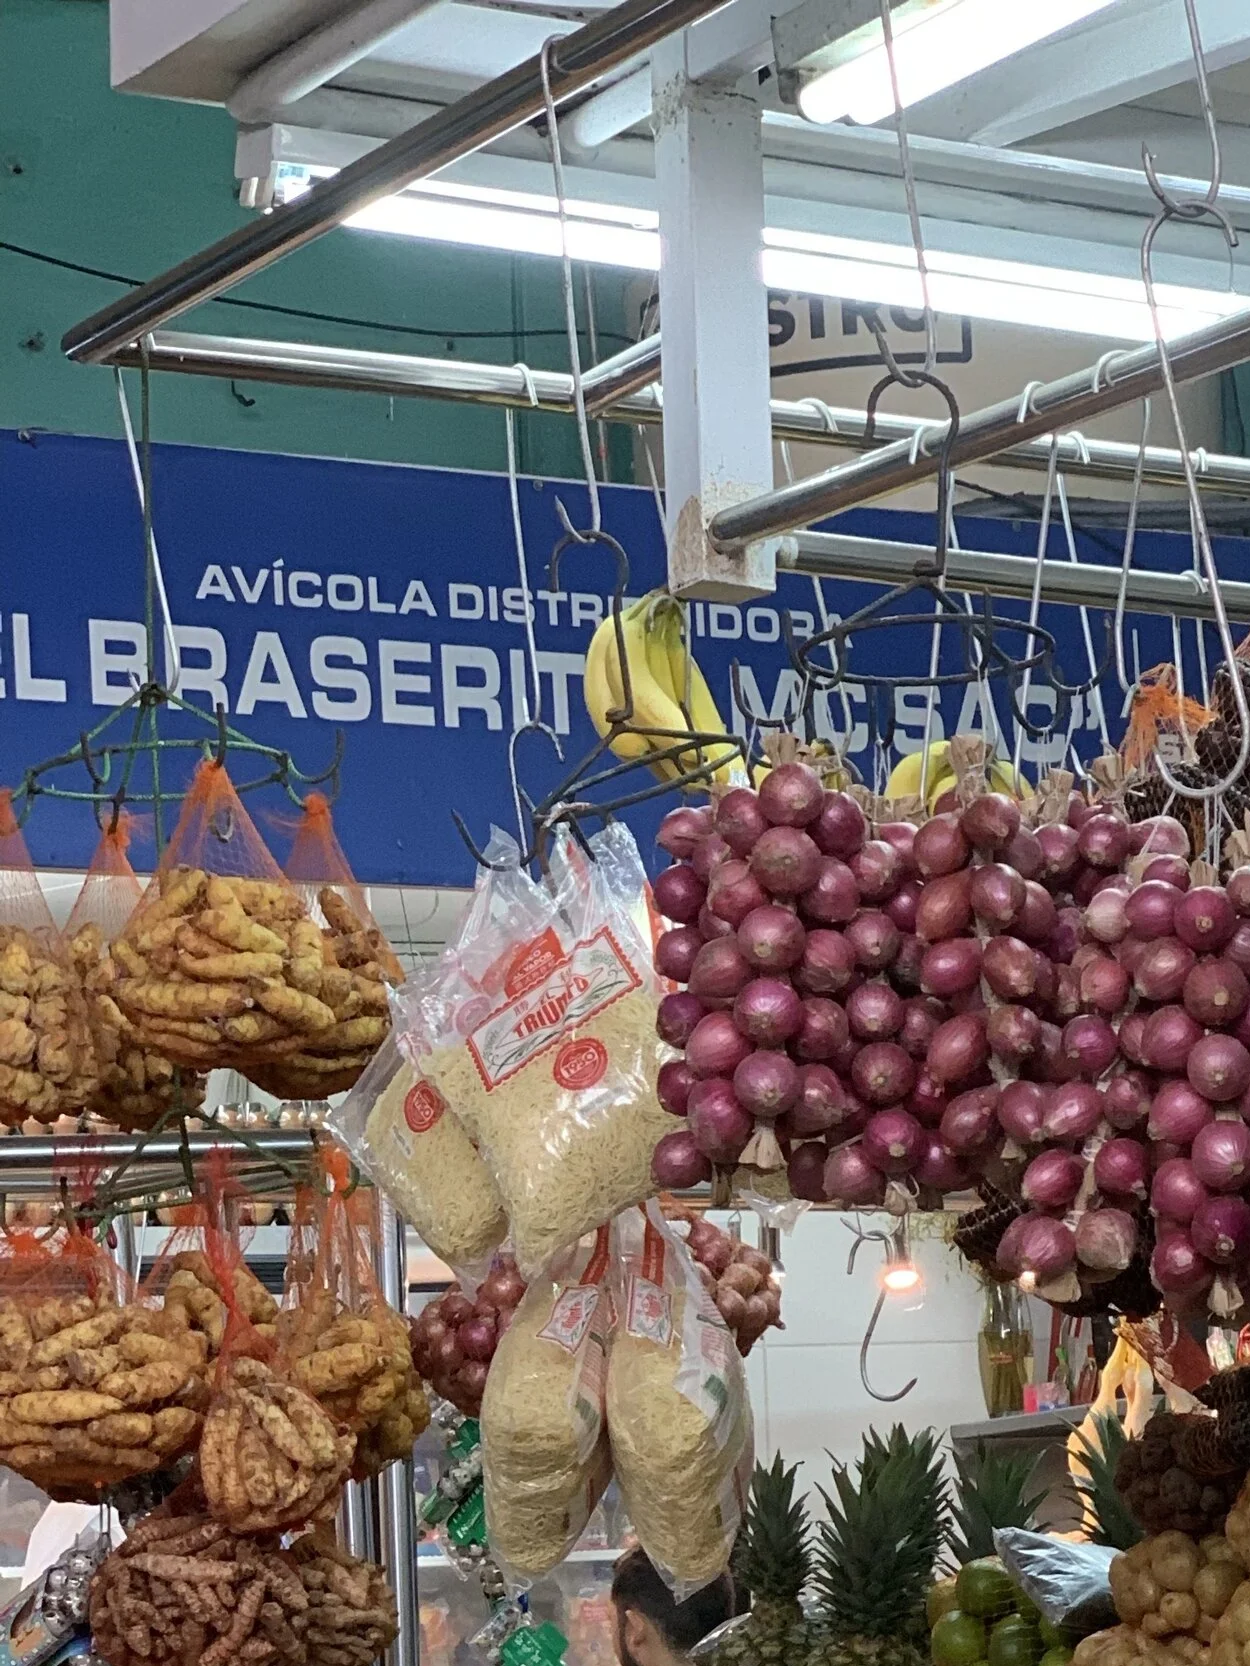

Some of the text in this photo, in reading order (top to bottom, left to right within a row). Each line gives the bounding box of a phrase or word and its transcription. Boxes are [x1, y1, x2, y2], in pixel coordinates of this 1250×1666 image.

[195, 557, 854, 649] AVÍCOLA DISTRIDORA
[0, 610, 67, 703] L
[88, 617, 588, 736] BRASERIT
